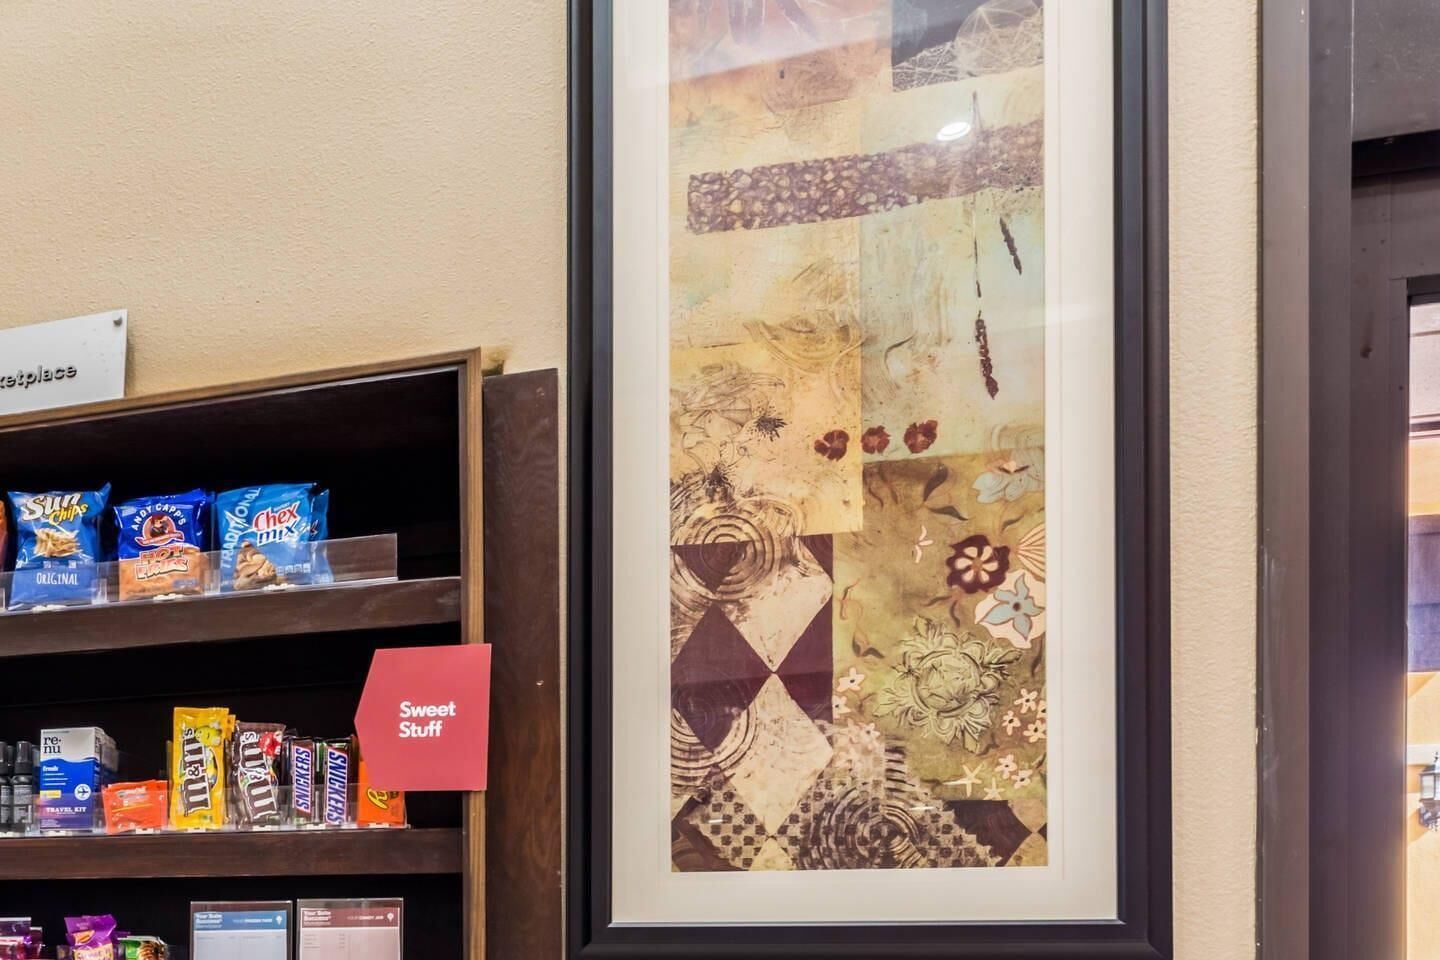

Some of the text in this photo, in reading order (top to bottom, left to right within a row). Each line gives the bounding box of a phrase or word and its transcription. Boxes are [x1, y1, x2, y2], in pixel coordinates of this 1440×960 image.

[22, 493, 81, 521] Sun
[48, 503, 89, 526] Chips
[131, 503, 186, 531] ANDY CAPP'S
[253, 501, 301, 532] Chex
[399, 701, 456, 718] Sweet
[398, 720, 443, 738] Stuff
[295, 748, 311, 811] SNICKERS
[327, 751, 347, 825] SNICKERS
